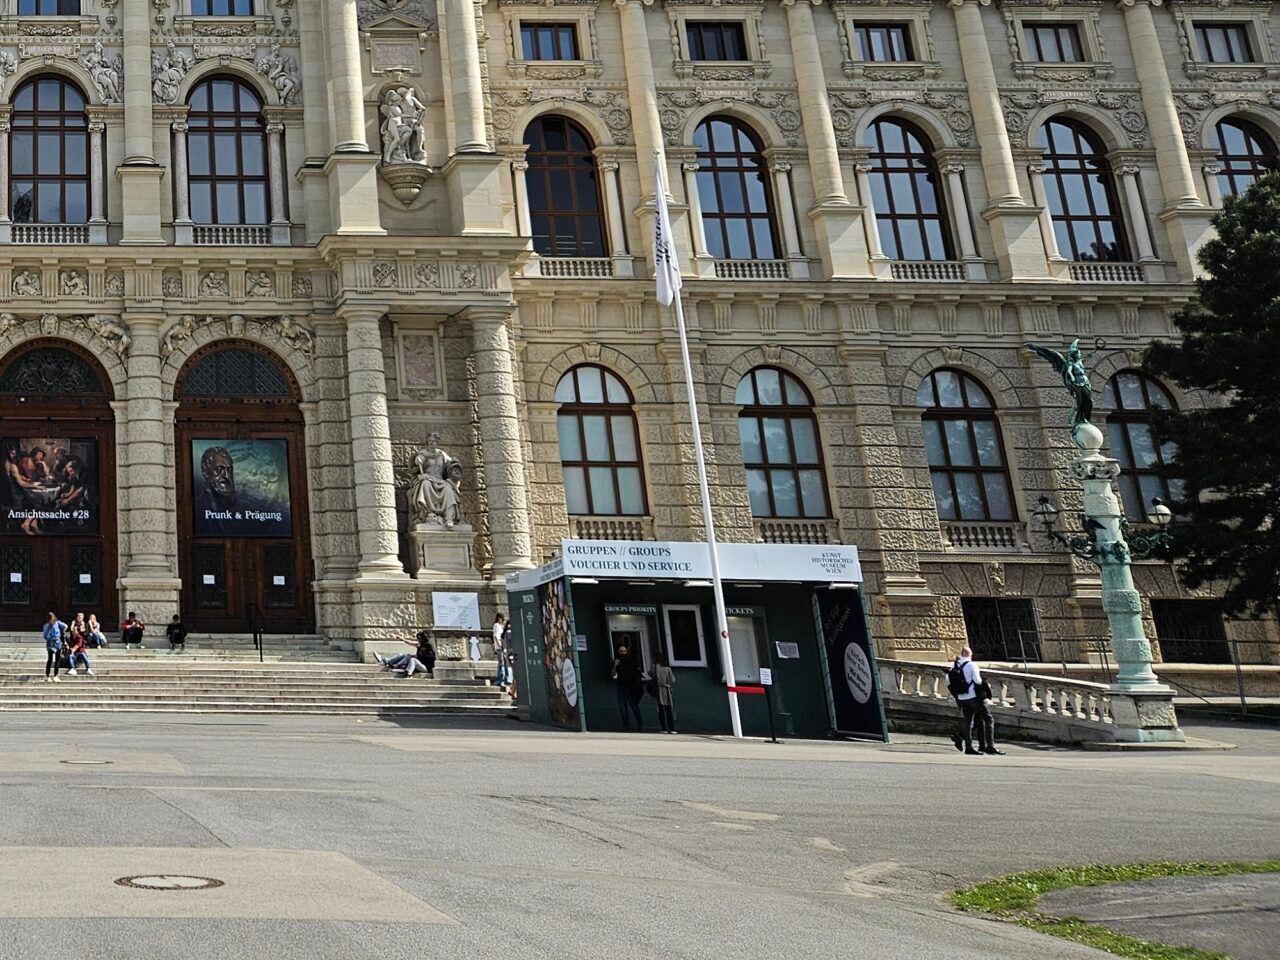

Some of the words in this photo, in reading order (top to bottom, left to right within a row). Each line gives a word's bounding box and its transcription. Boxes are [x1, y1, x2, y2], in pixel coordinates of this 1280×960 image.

[7, 509, 71, 519] Ansichtssache
[72, 509, 90, 519] #28
[204, 509, 233, 520] Prunk
[234, 511, 242, 520] &
[245, 510, 282, 521] Prägung
[567, 545, 617, 556] GRUPPEN
[628, 546, 672, 557] GROUPS
[570, 559, 621, 570] VOUCHER
[623, 560, 646, 571] UND
[647, 561, 693, 572] SERVICE
